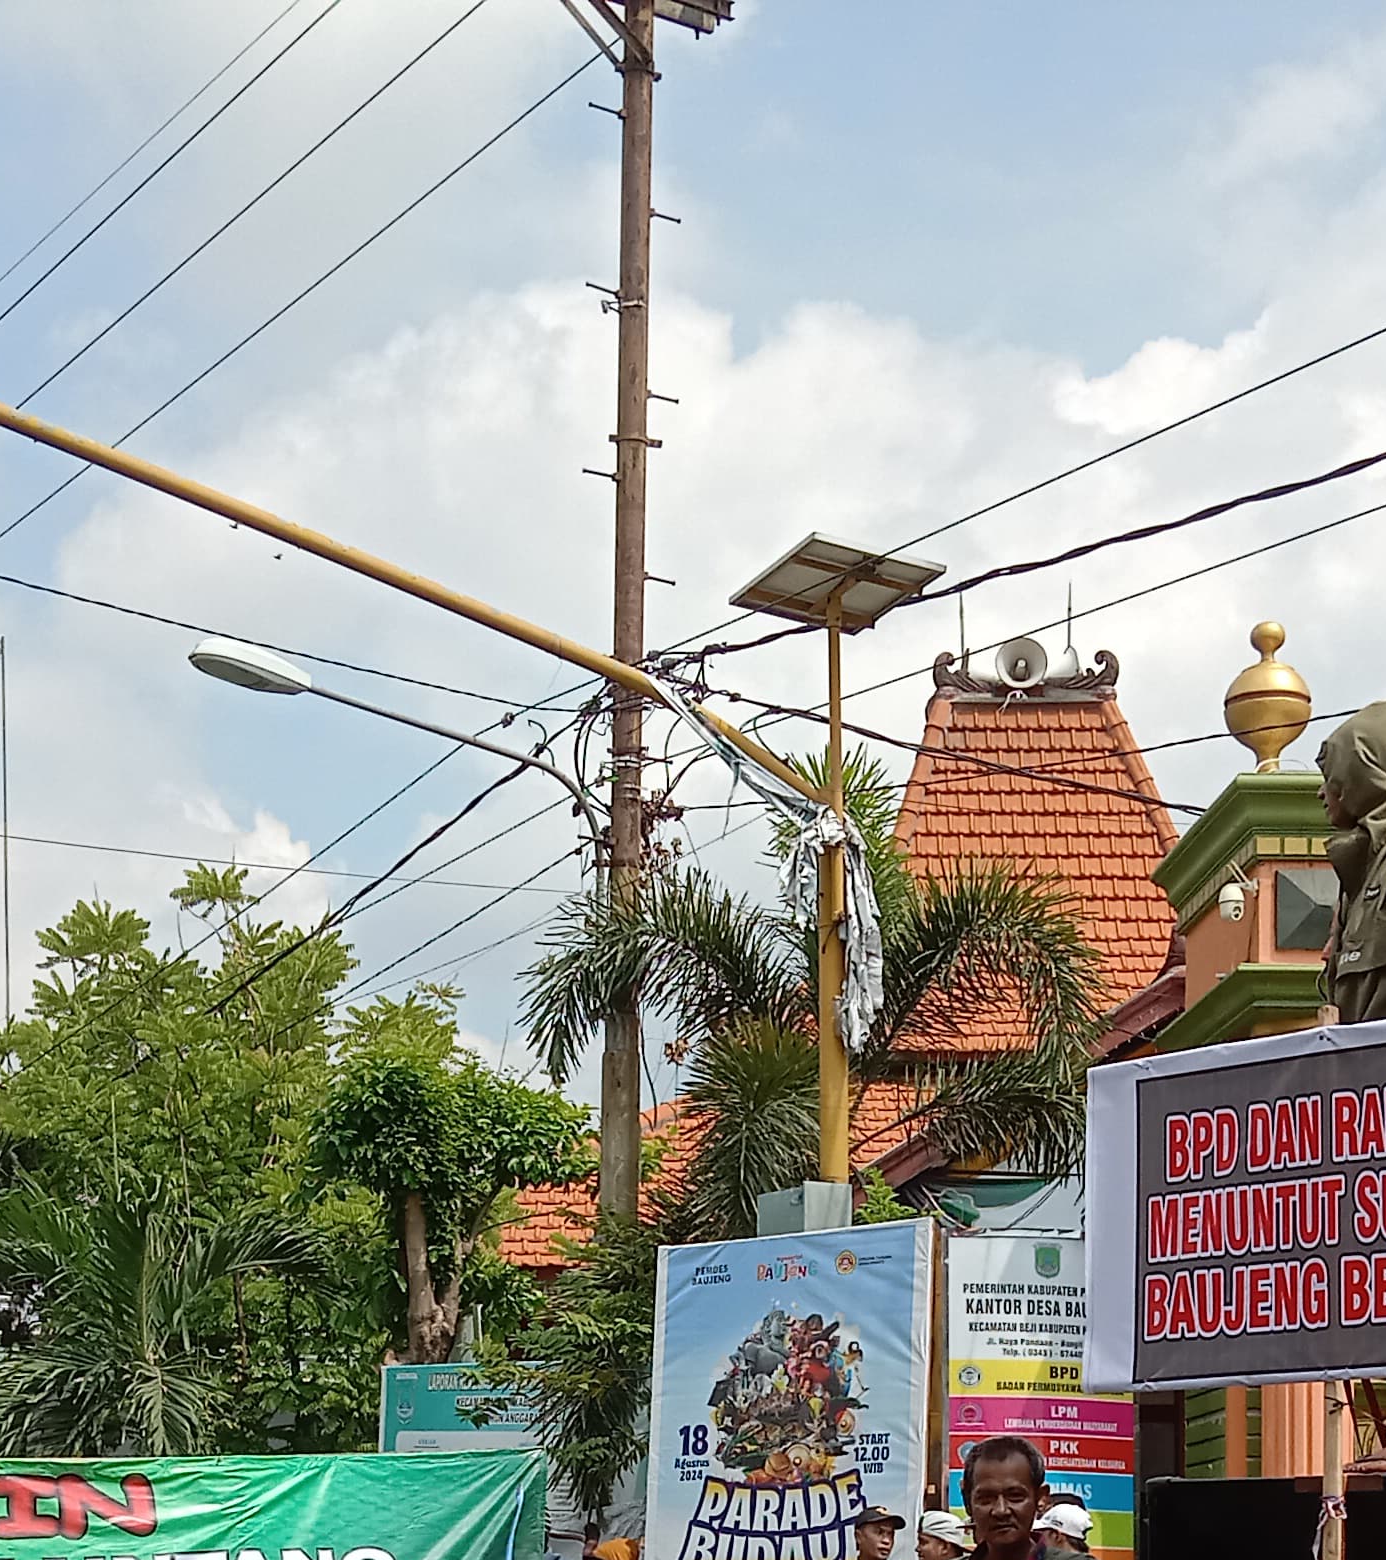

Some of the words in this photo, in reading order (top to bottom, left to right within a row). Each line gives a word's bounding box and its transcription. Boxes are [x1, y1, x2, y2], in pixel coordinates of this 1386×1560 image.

[1165, 1109, 1237, 1184] BPD
[1247, 1095, 1321, 1173] DAN
[1147, 1174, 1345, 1264] MENUNTUT
[963, 1284, 1025, 1295] PEMERINTAH
[1027, 1285, 1078, 1297] KABUPATEN
[966, 1299, 1022, 1315] KANTOR
[1027, 1301, 1061, 1317] DESA
[1143, 1260, 1328, 1343] BAUJENG
[969, 1322, 1017, 1333] KECAMATAN
[1019, 1322, 1037, 1333] BEJI
[1039, 1323, 1081, 1335] KABUPATEN
[1049, 1366, 1079, 1379] BPD
[1050, 1406, 1078, 1418] LPM
[679, 1425, 709, 1457] 18
[858, 1433, 891, 1446] START
[853, 1446, 890, 1462] 12.00
[1049, 1440, 1079, 1455] PKK
[679, 1471, 703, 1481] 2024
[863, 1463, 884, 1474] WIB
[694, 1470, 865, 1531] PARADE
